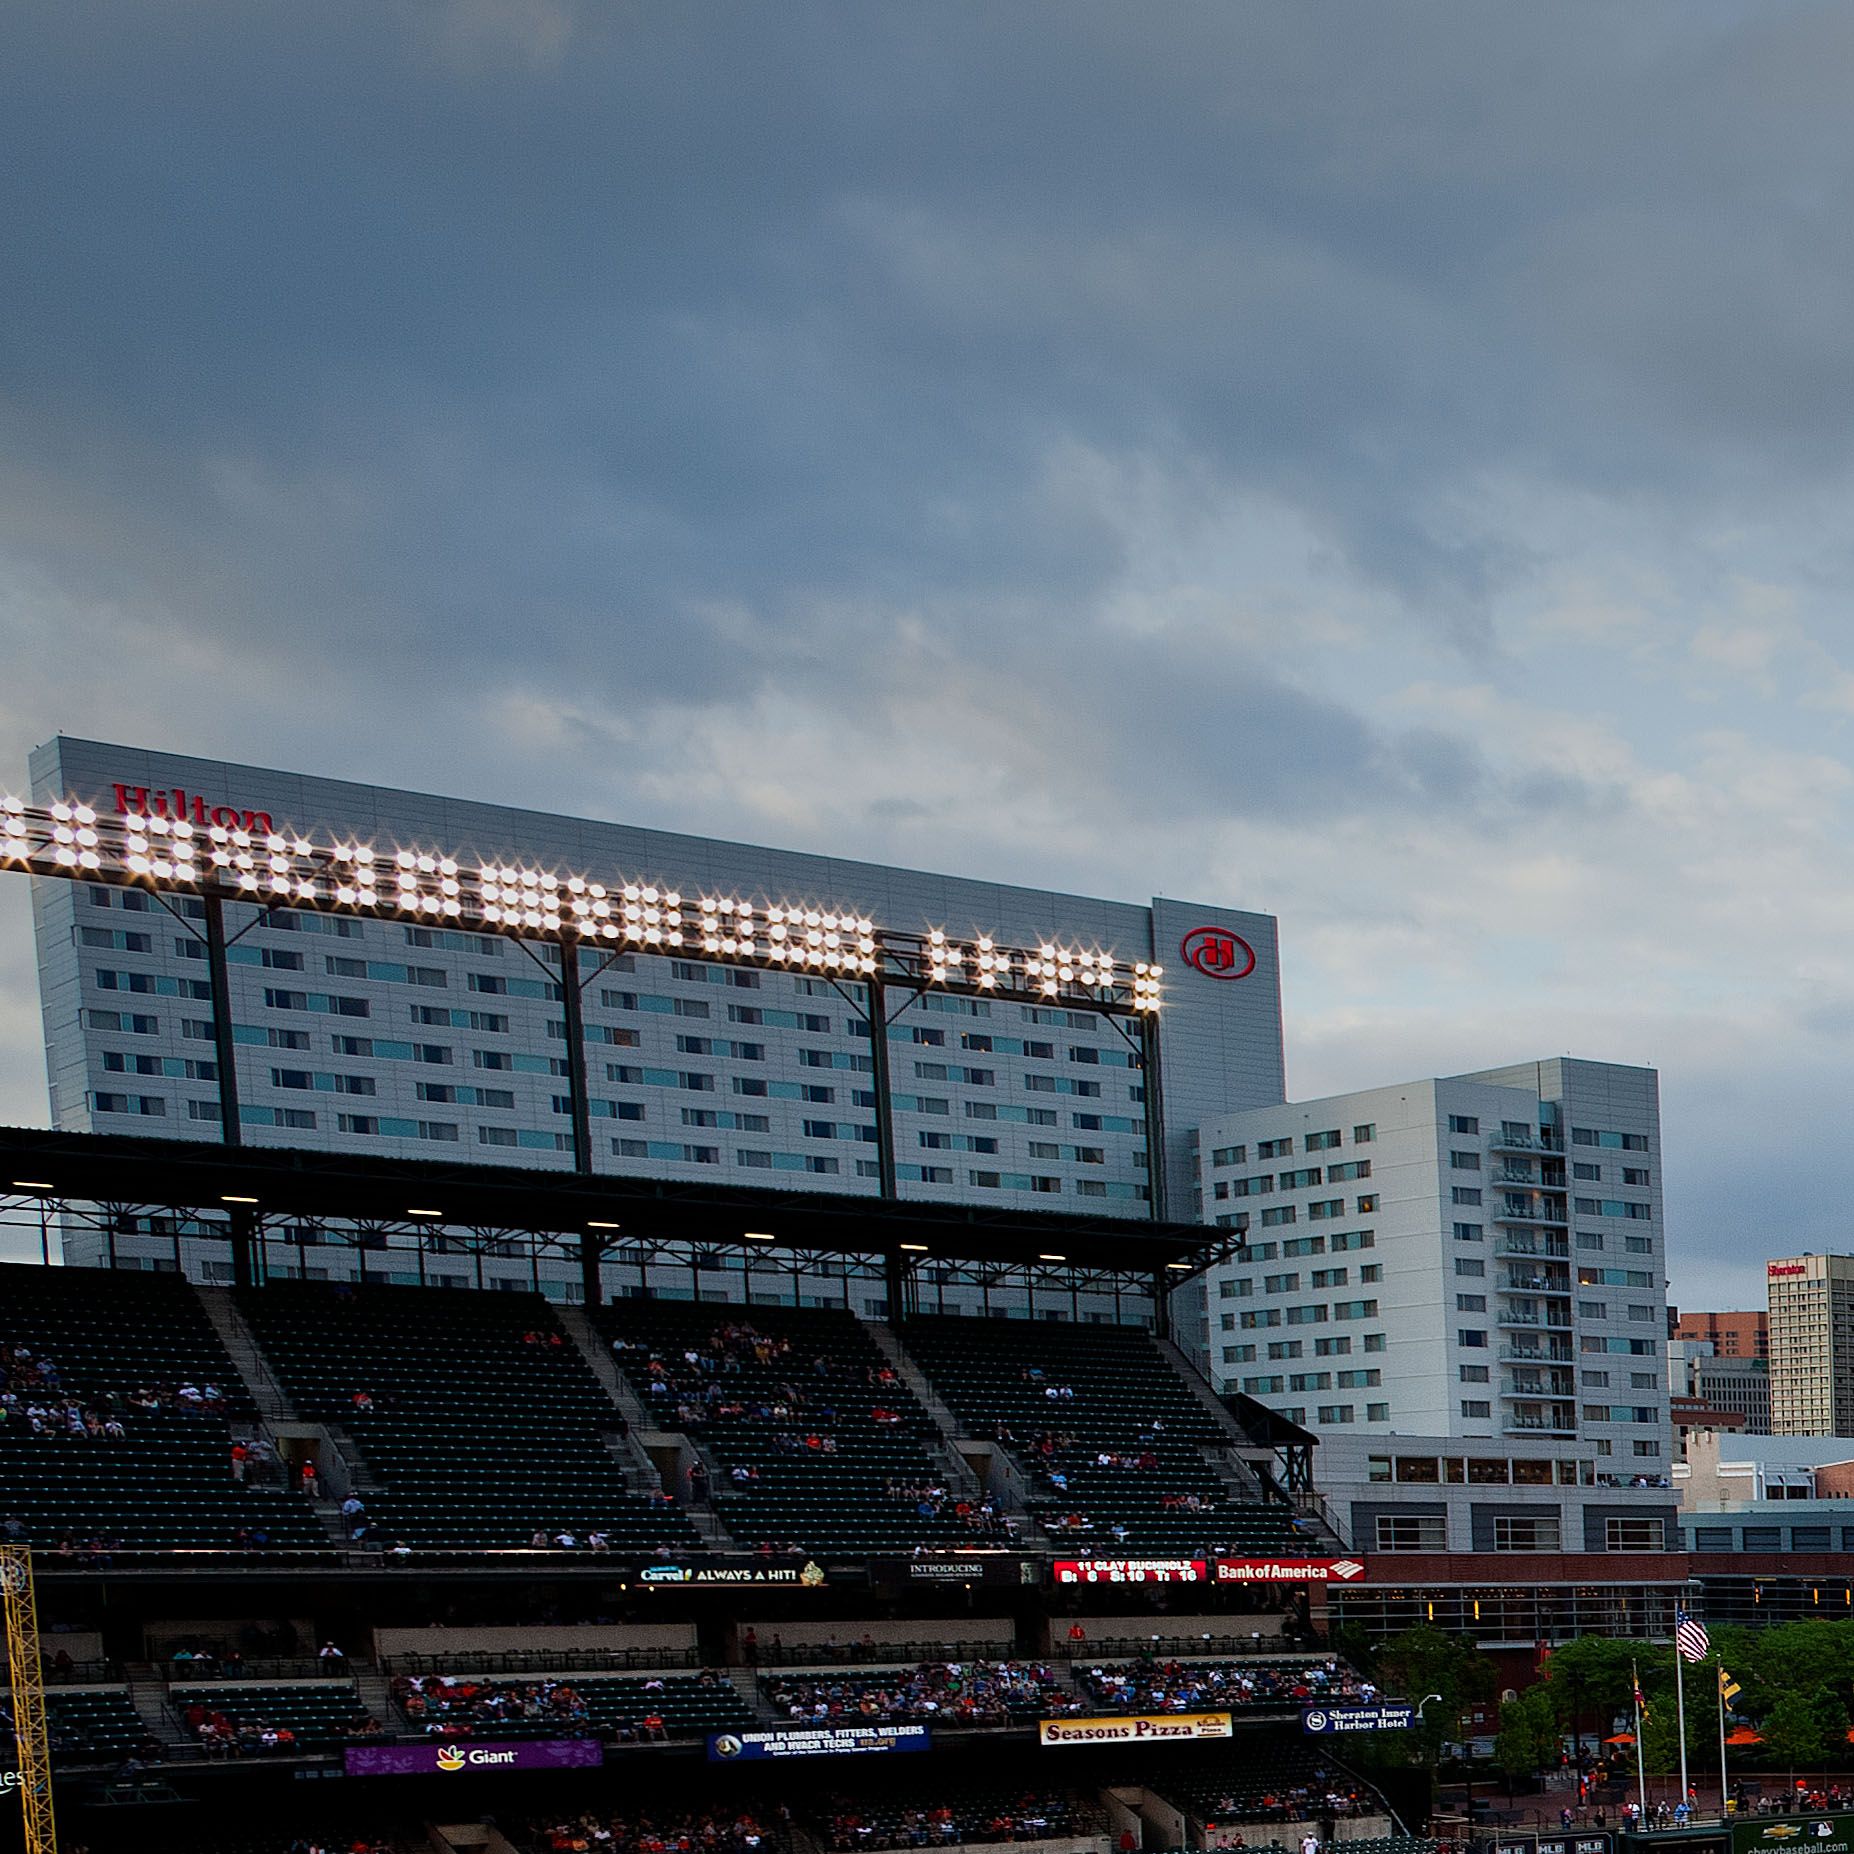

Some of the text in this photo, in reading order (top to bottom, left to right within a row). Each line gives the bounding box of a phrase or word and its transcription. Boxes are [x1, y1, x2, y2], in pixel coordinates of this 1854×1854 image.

[112, 783, 277, 834] Hilton
[910, 1564, 983, 1573] INTRODUCING
[1094, 1561, 1126, 1571] CLAY
[1127, 1561, 1192, 1571] BUCHHOLZ
[641, 1570, 684, 1581] Carvel
[697, 1570, 796, 1581] ALWAYS A HIT!
[1328, 1707, 1412, 1720] Sheraton Inner
[1334, 1718, 1408, 1730] Harbor Hotel
[742, 1732, 774, 1743] UNION
[835, 1728, 877, 1740] FITTERS,
[878, 1725, 924, 1737] WELDERS
[1048, 1723, 1130, 1741] Seasons
[1135, 1720, 1193, 1738] Pizza
[468, 1751, 515, 1765] Giant
[1539, 1844, 1565, 1854] MLB
[1578, 1841, 1604, 1852] MLB
